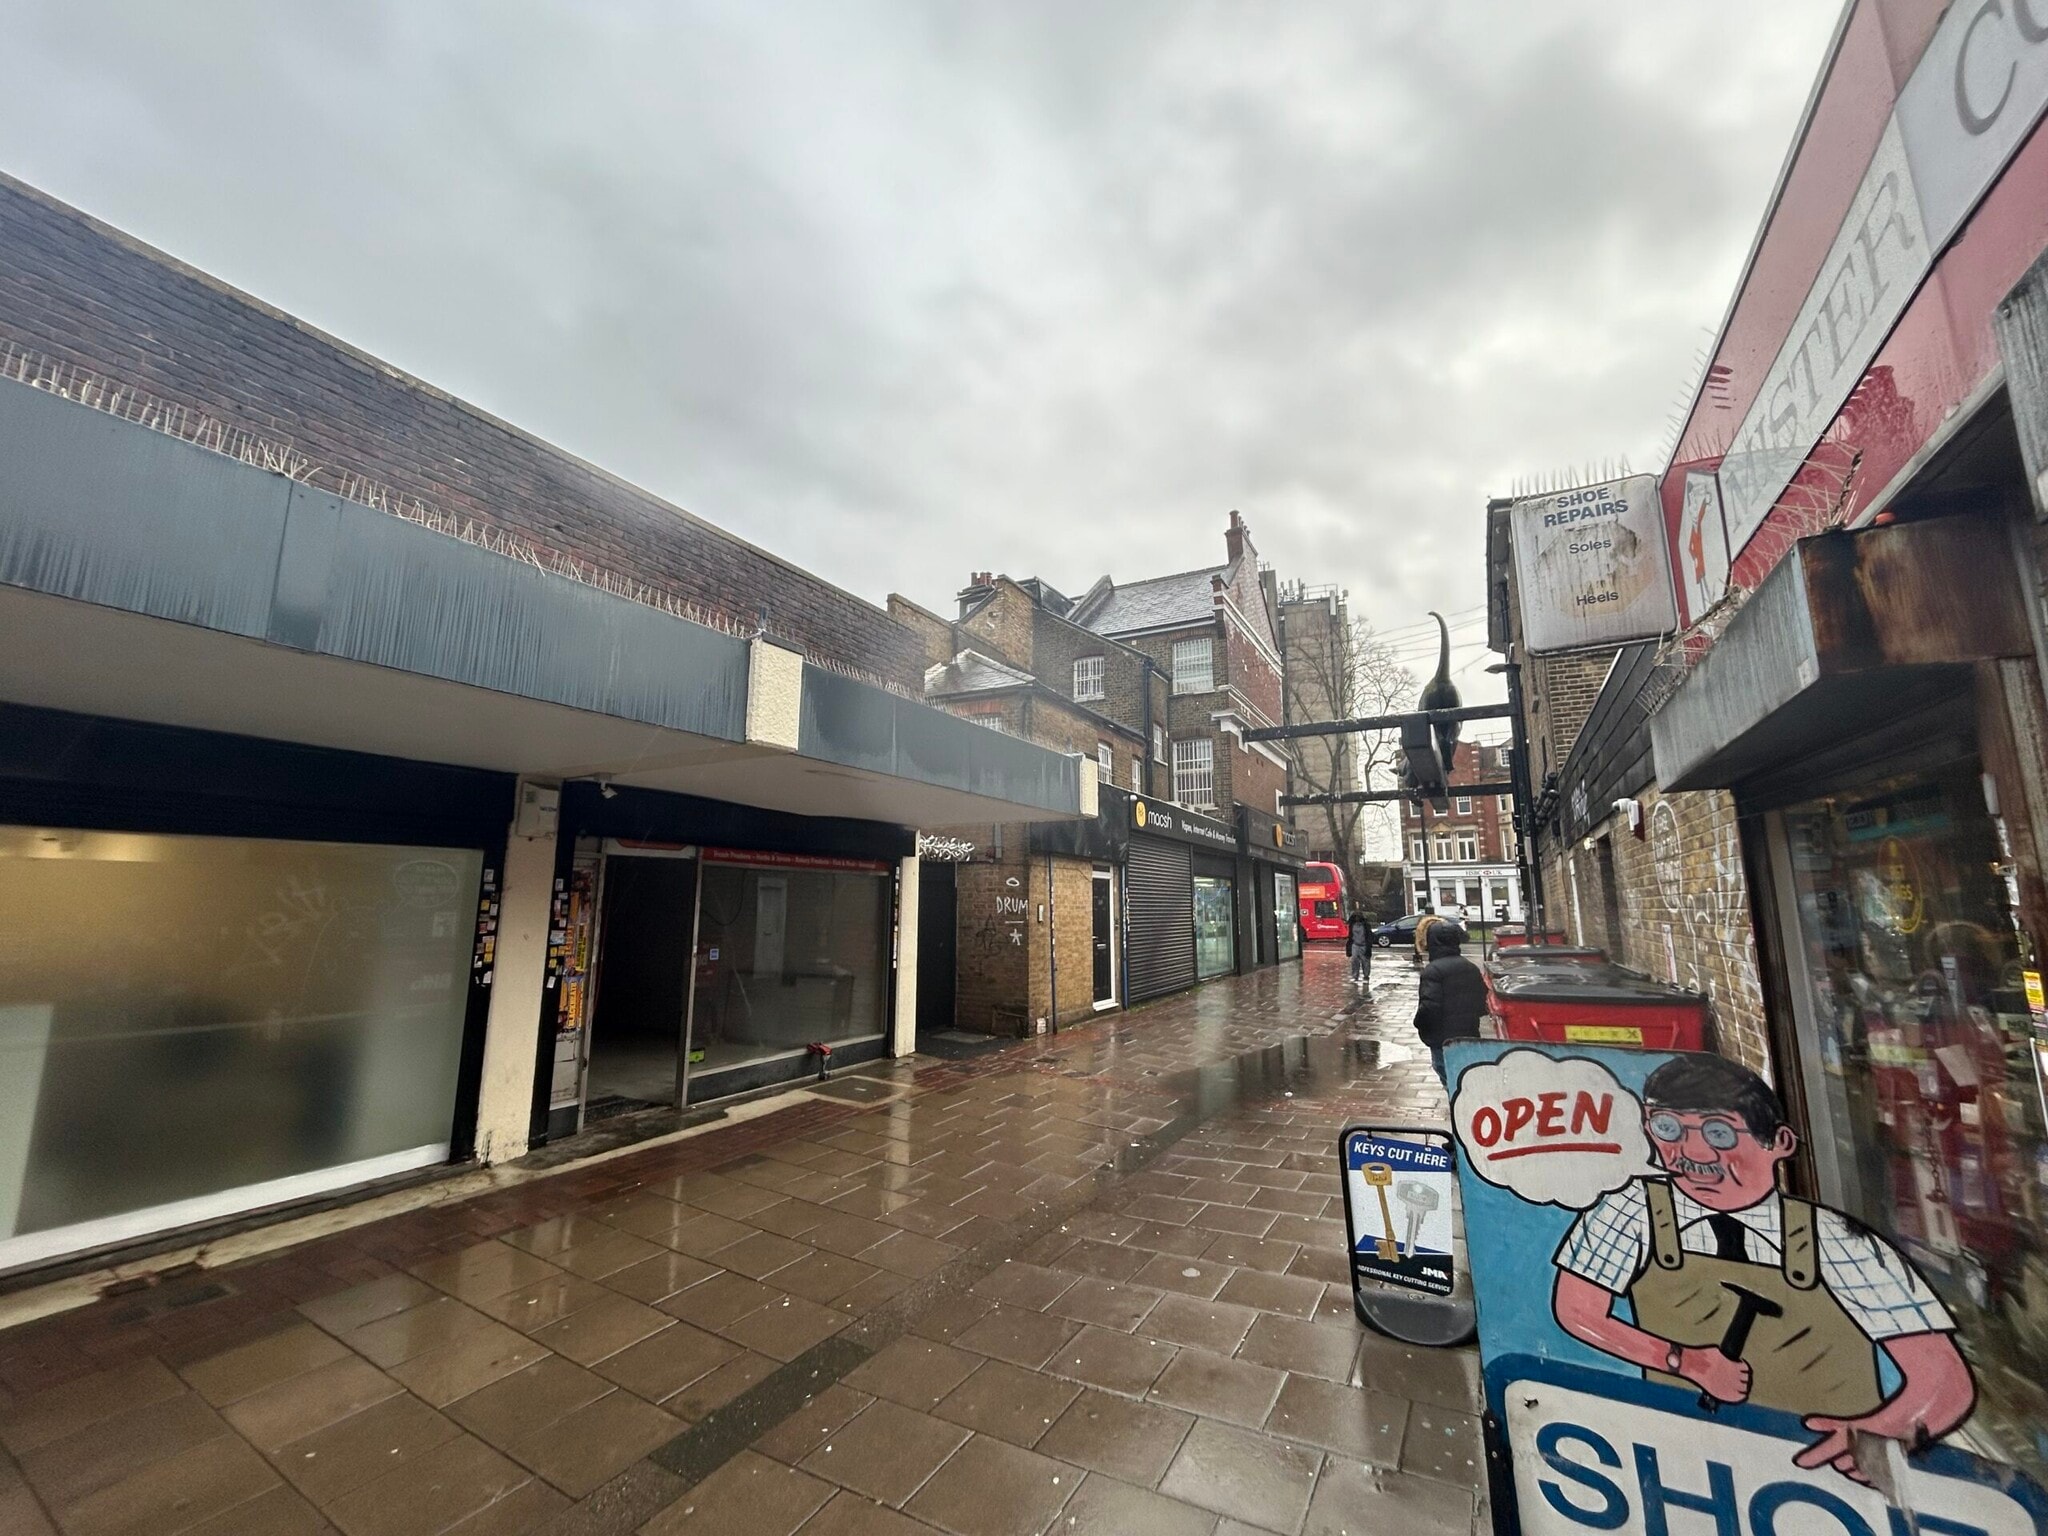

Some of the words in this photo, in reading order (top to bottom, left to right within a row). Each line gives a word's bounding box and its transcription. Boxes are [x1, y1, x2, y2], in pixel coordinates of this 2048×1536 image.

[1724, 170, 1916, 533] MISTER
[1556, 487, 1610, 508] SHOE
[1543, 499, 1629, 528] REPAIRS
[1569, 538, 1612, 554] Soles
[1576, 590, 1619, 606] Heels
[1147, 811, 1173, 830] mocsh
[996, 895, 1029, 920] DRUM
[1470, 1090, 1614, 1148] OPEN
[1353, 1141, 1386, 1157] KEYS
[1387, 1147, 1413, 1161] CUT
[1414, 1151, 1448, 1168] HERE
[1392, 1272, 1403, 1281] KEY
[1403, 1275, 1427, 1287] CUTTING
[1427, 1280, 1451, 1293] SERVICE
[1420, 1266, 1448, 1280] JMA
